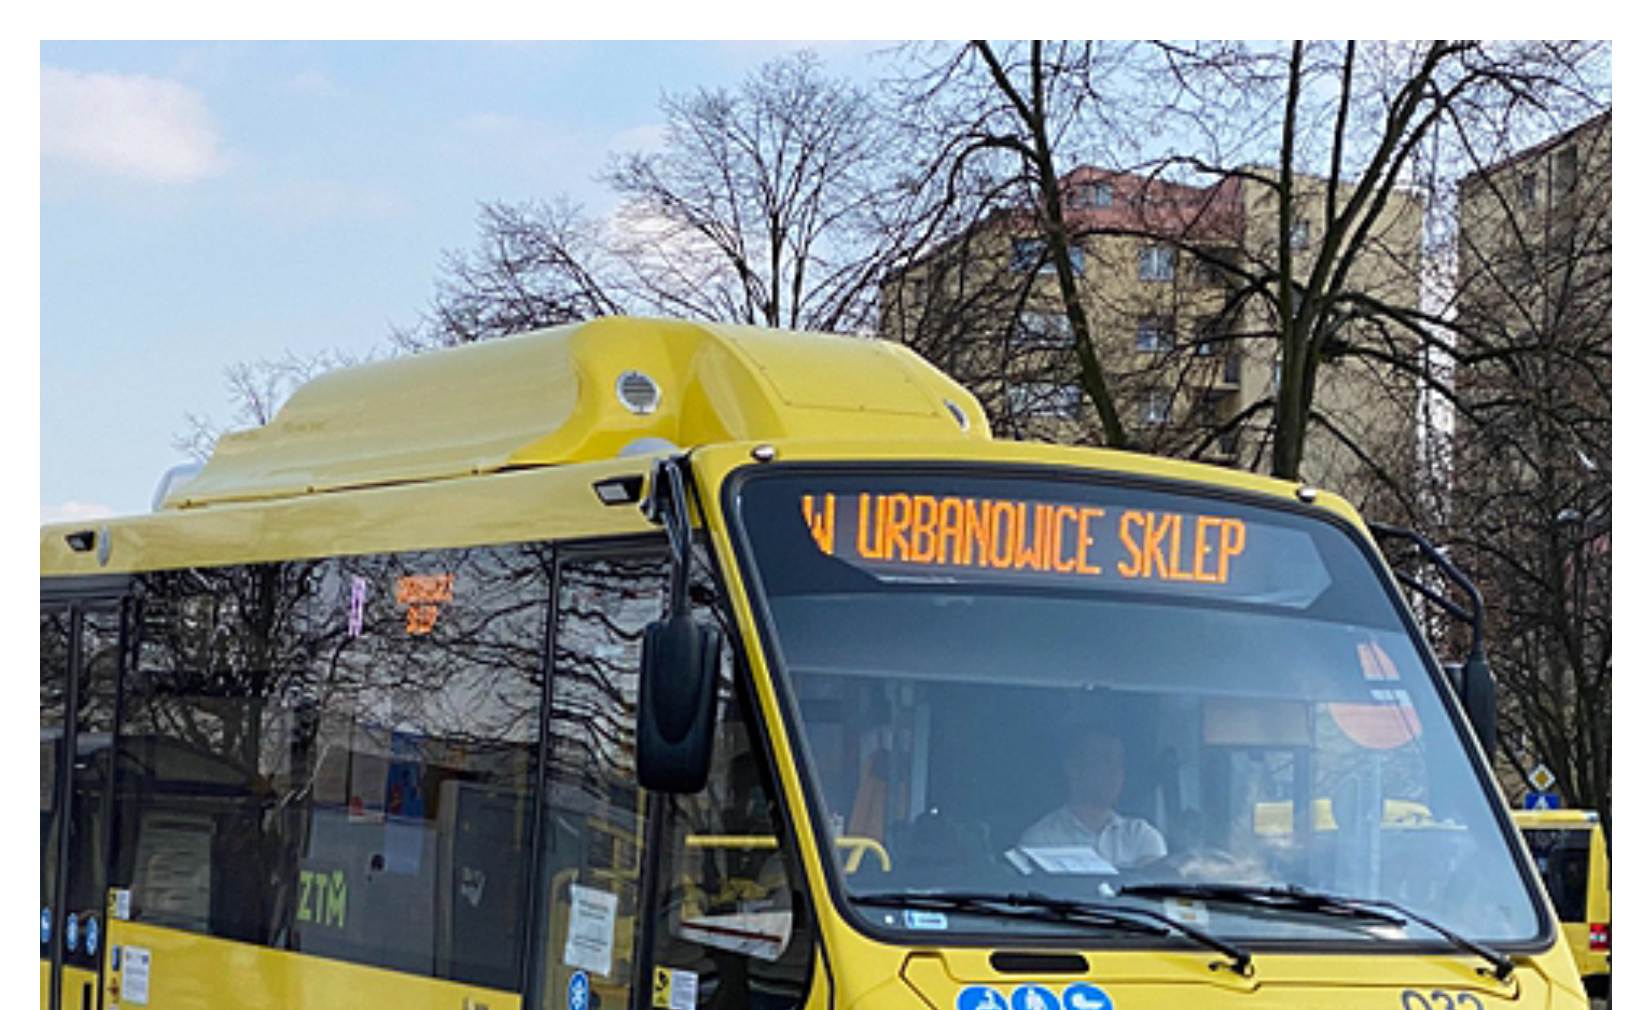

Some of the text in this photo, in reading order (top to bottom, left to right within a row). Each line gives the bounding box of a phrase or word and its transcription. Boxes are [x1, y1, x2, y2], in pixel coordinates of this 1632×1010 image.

[857, 492, 1105, 575] URBANOWICE
[1117, 509, 1247, 583] SKLEP
[296, 869, 348, 928] ZTM
